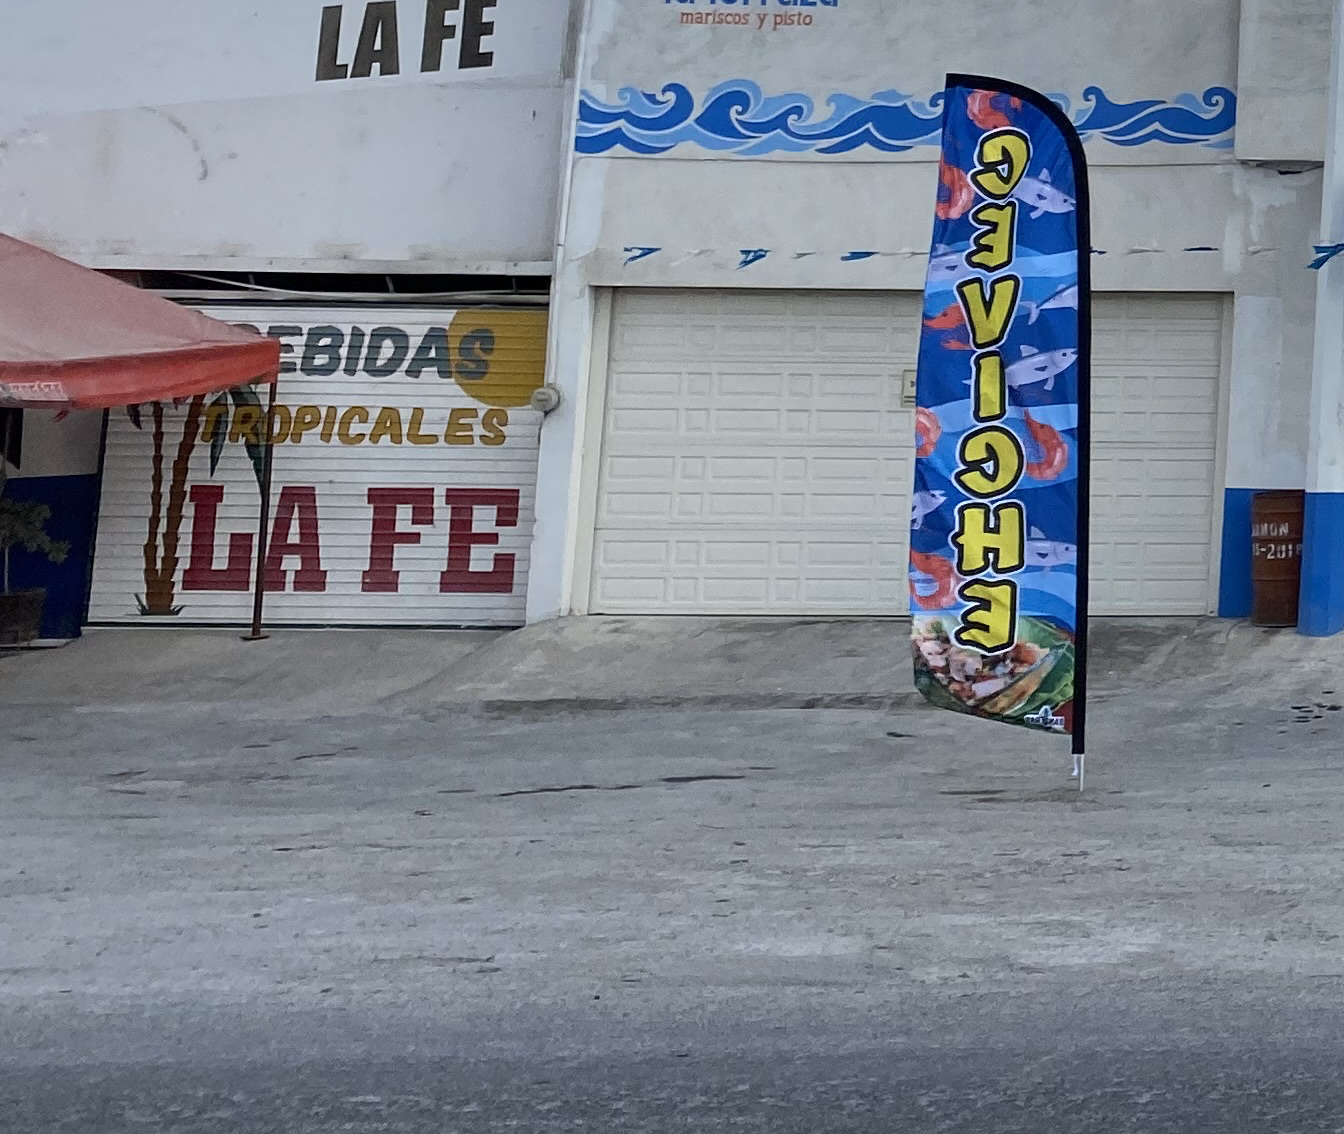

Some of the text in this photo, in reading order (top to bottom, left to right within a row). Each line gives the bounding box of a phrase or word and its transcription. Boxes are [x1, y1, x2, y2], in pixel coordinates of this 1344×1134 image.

[315, 0, 400, 81] LA
[680, 9, 750, 25] mariscos
[773, 10, 813, 30] pisto
[232, 324, 494, 380] EBIDAS
[200, 405, 509, 445] TROPICALES
[182, 485, 520, 593] LA FE
